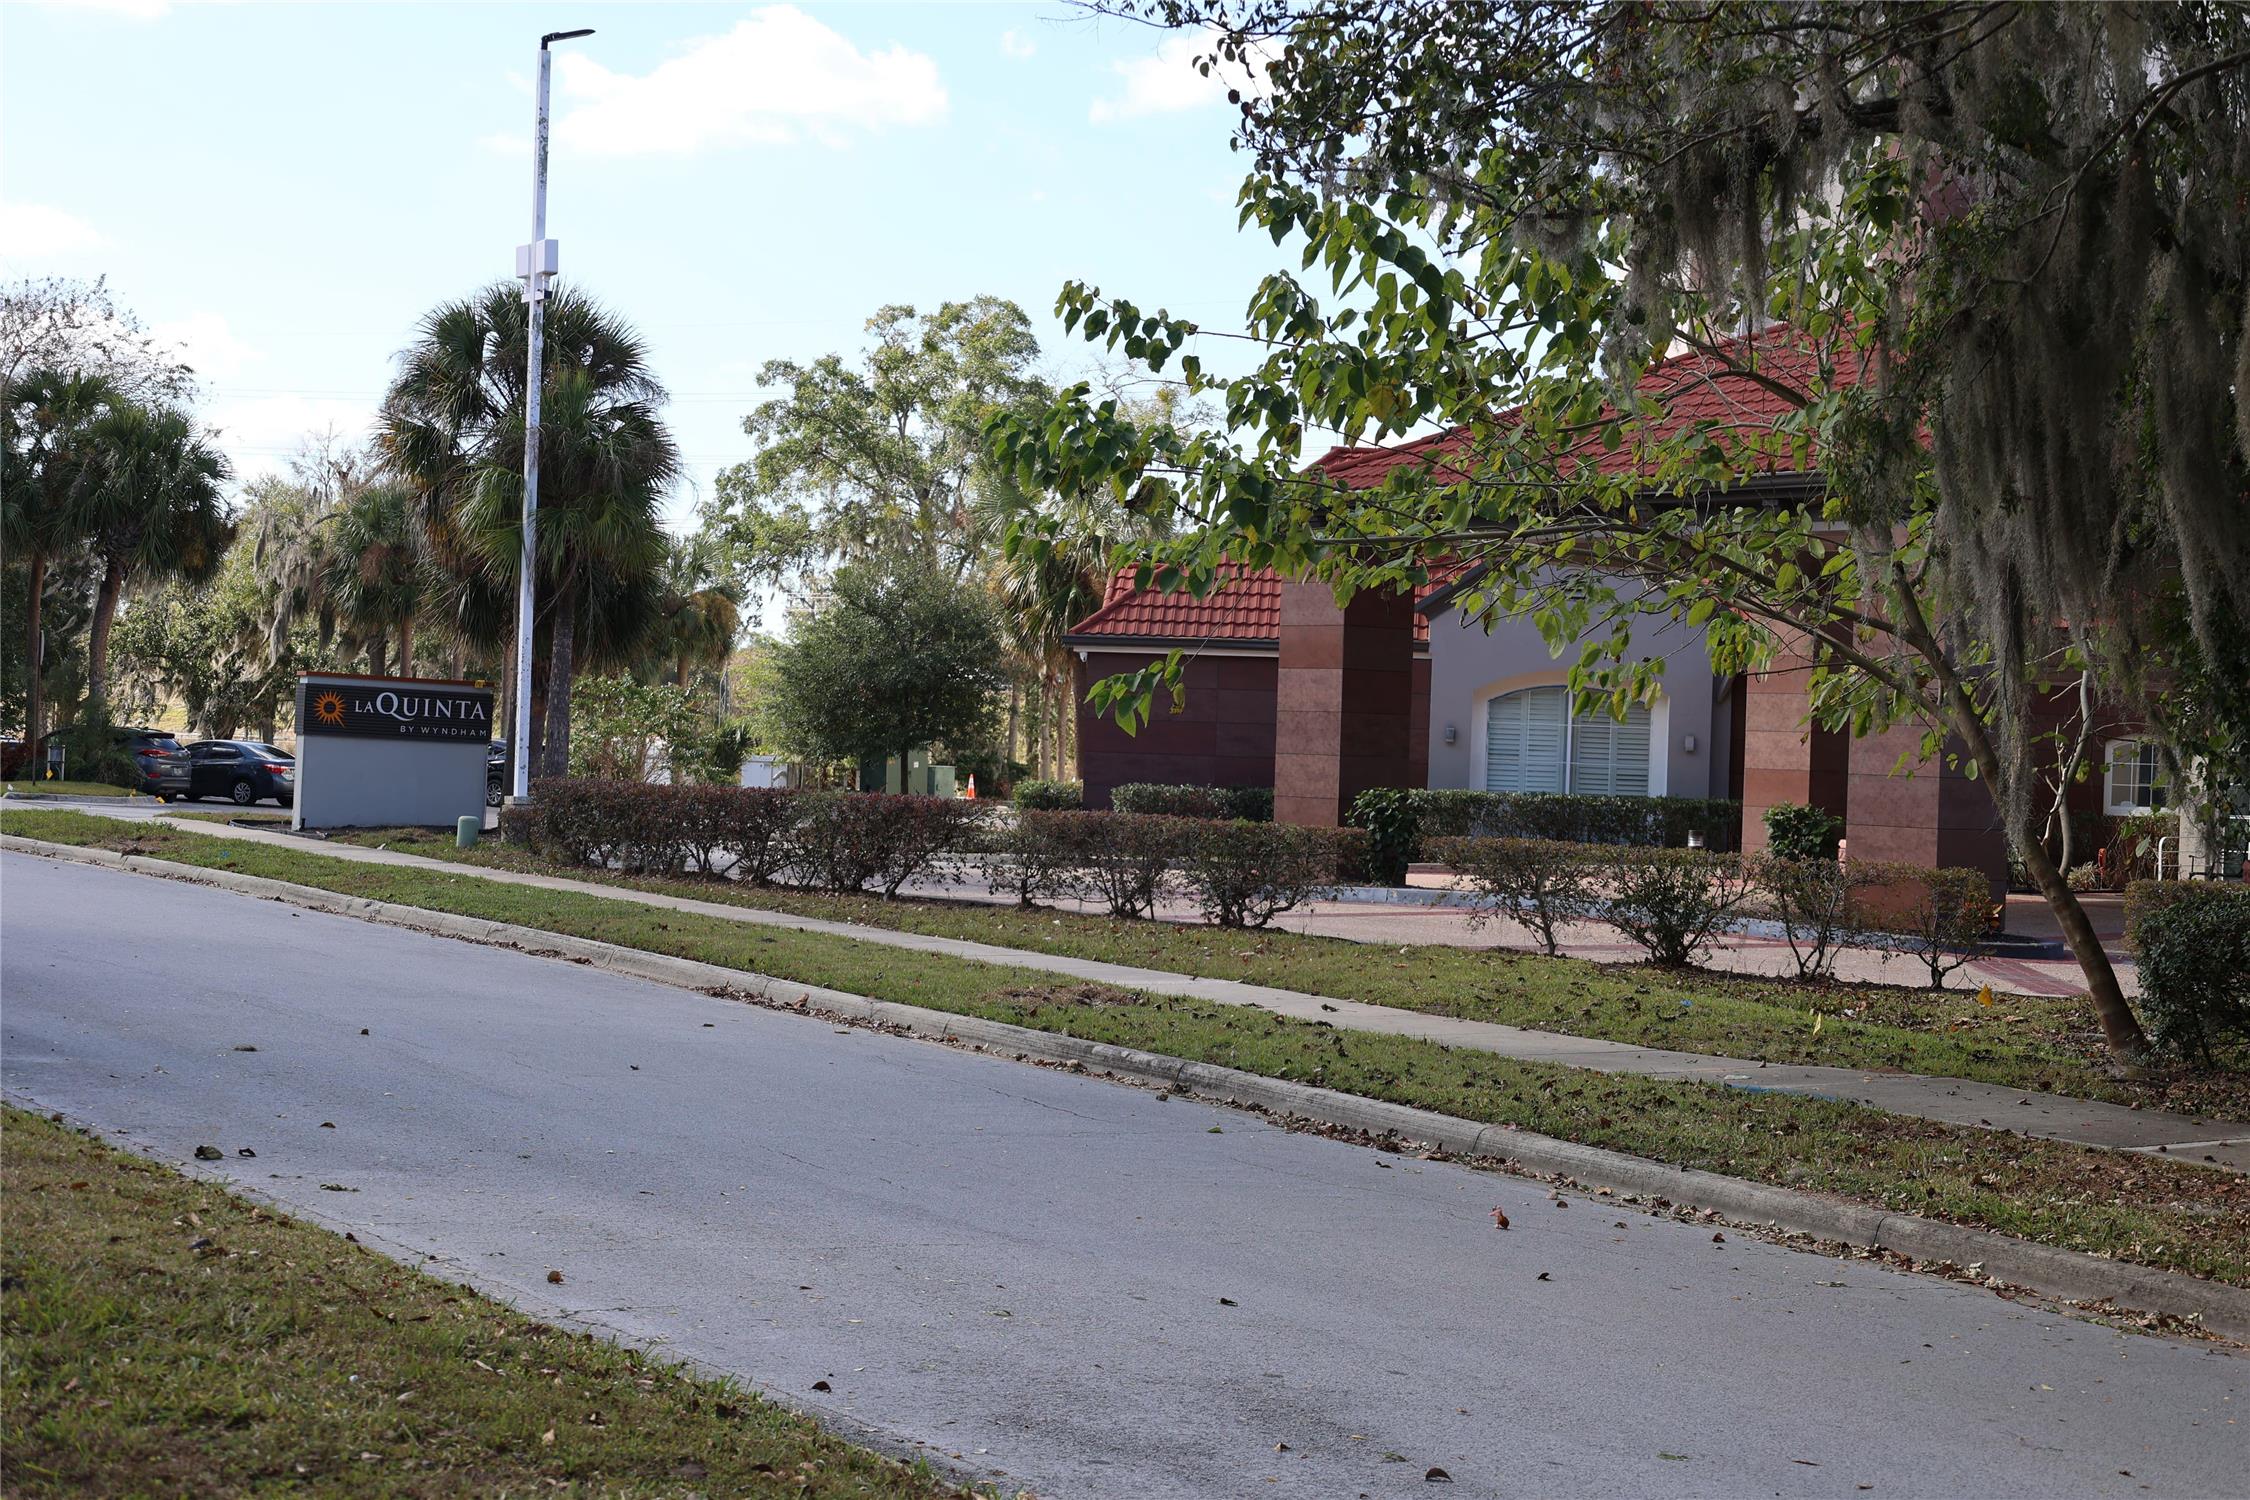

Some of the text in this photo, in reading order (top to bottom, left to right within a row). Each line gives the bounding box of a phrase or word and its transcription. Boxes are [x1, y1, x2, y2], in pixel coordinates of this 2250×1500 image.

[376, 692, 486, 721] QUINTA
[400, 725, 487, 737] BY WYNDHAM
